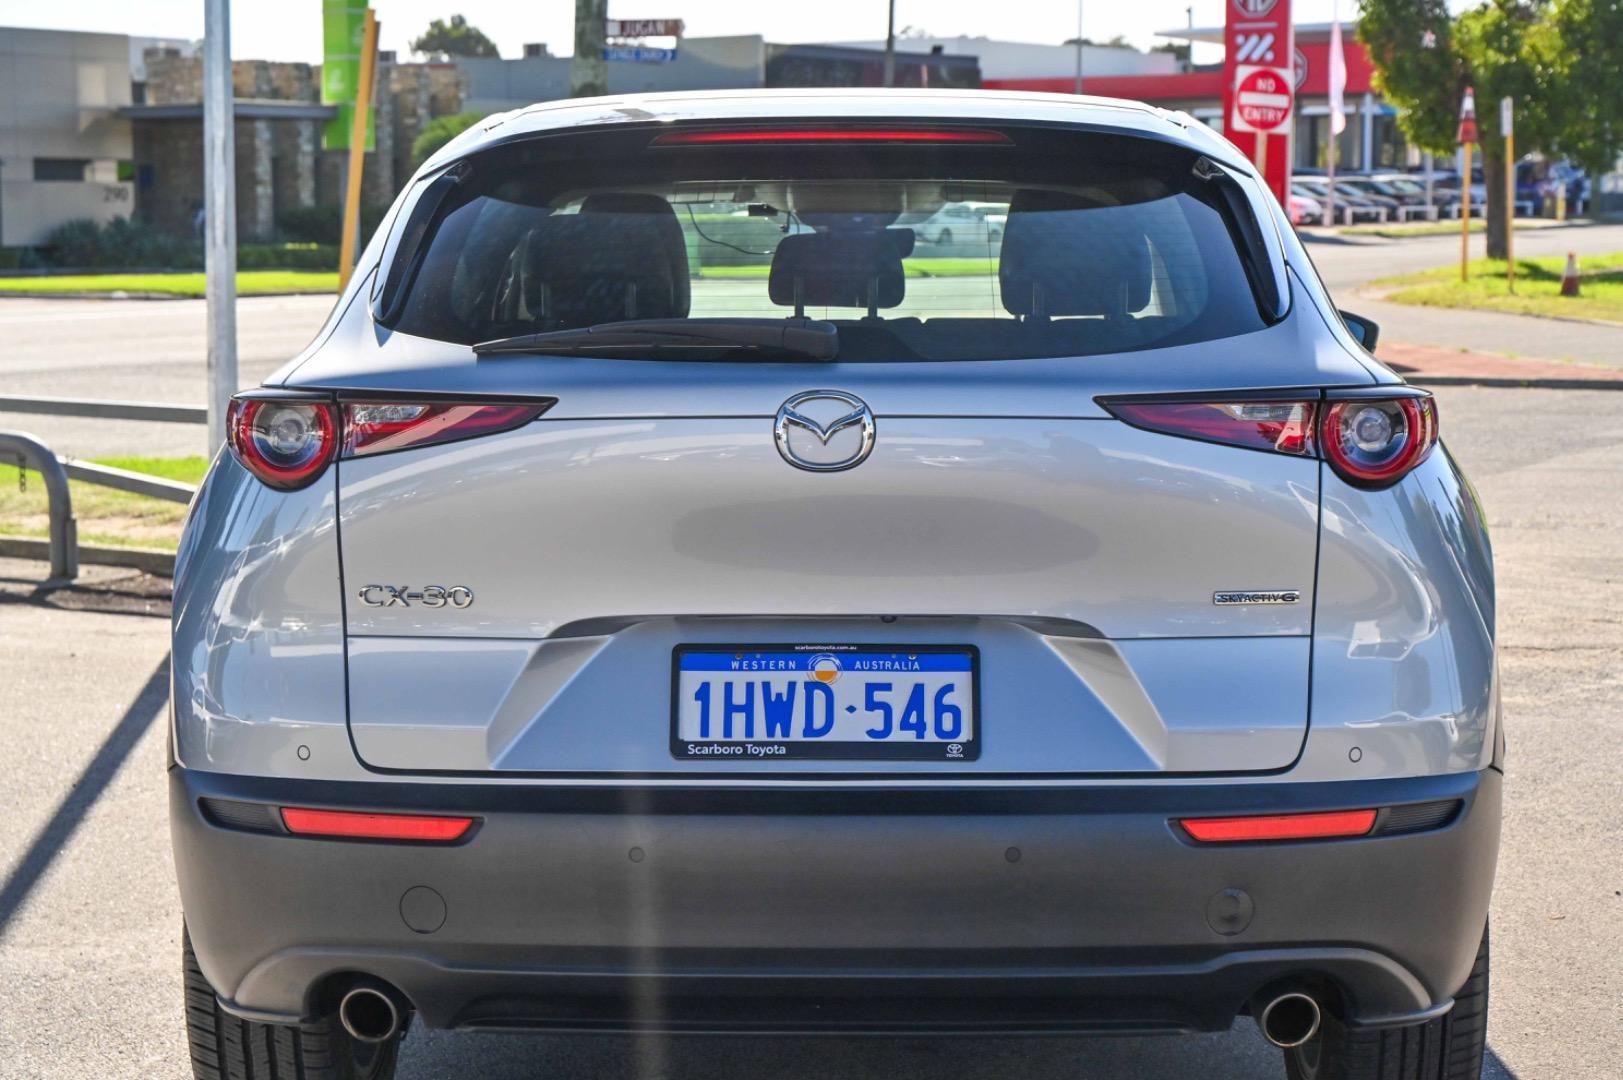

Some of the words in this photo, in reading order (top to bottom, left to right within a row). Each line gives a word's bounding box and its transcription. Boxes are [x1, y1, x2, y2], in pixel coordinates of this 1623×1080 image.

[623, 20, 665, 35] JUGAN
[1257, 78, 1275, 92] NO
[1244, 107, 1284, 121] ENTRY
[358, 584, 473, 609] CX-30
[731, 660, 796, 670] WESTERN
[854, 660, 921, 671] AUSTRALIA
[687, 743, 743, 755] Scarboro
[745, 743, 786, 757] Toyota
